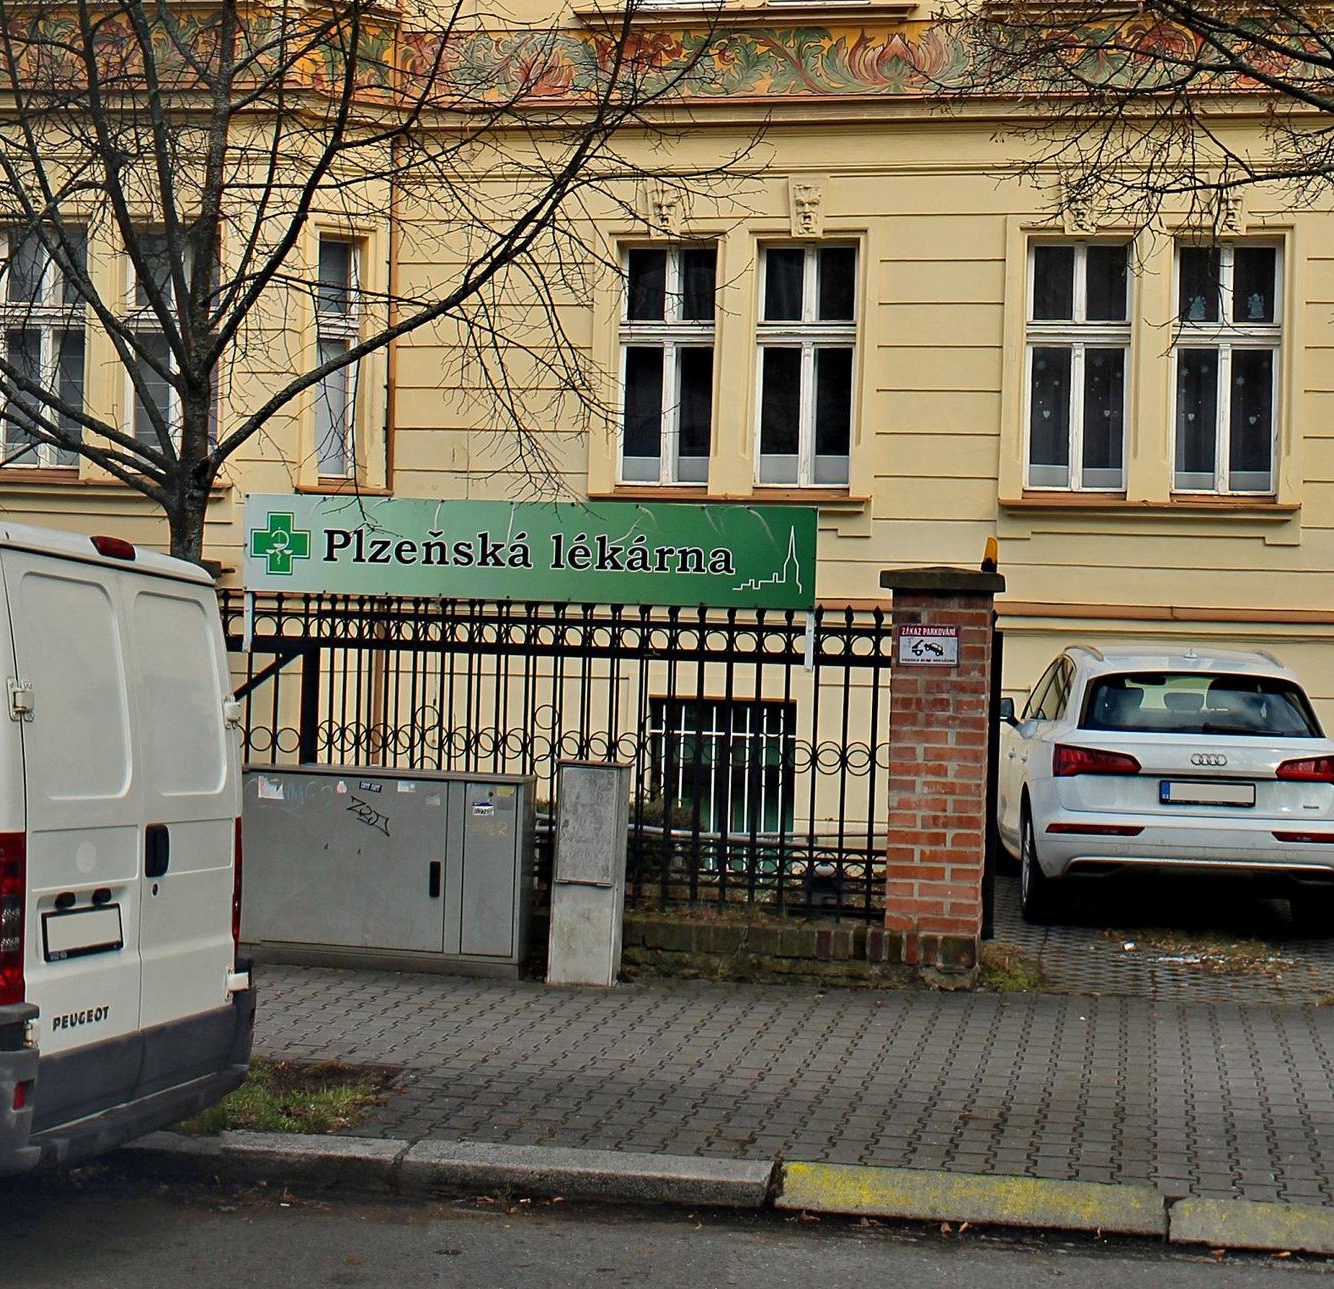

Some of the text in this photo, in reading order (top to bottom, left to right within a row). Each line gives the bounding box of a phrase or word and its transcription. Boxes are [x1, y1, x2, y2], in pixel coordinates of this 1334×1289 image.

[323, 529, 736, 575] Plzeňská lékárna
[901, 626, 956, 637] ZÁKAZ PARKOVÁNÍ
[52, 1006, 109, 1032] PEUGEOT
